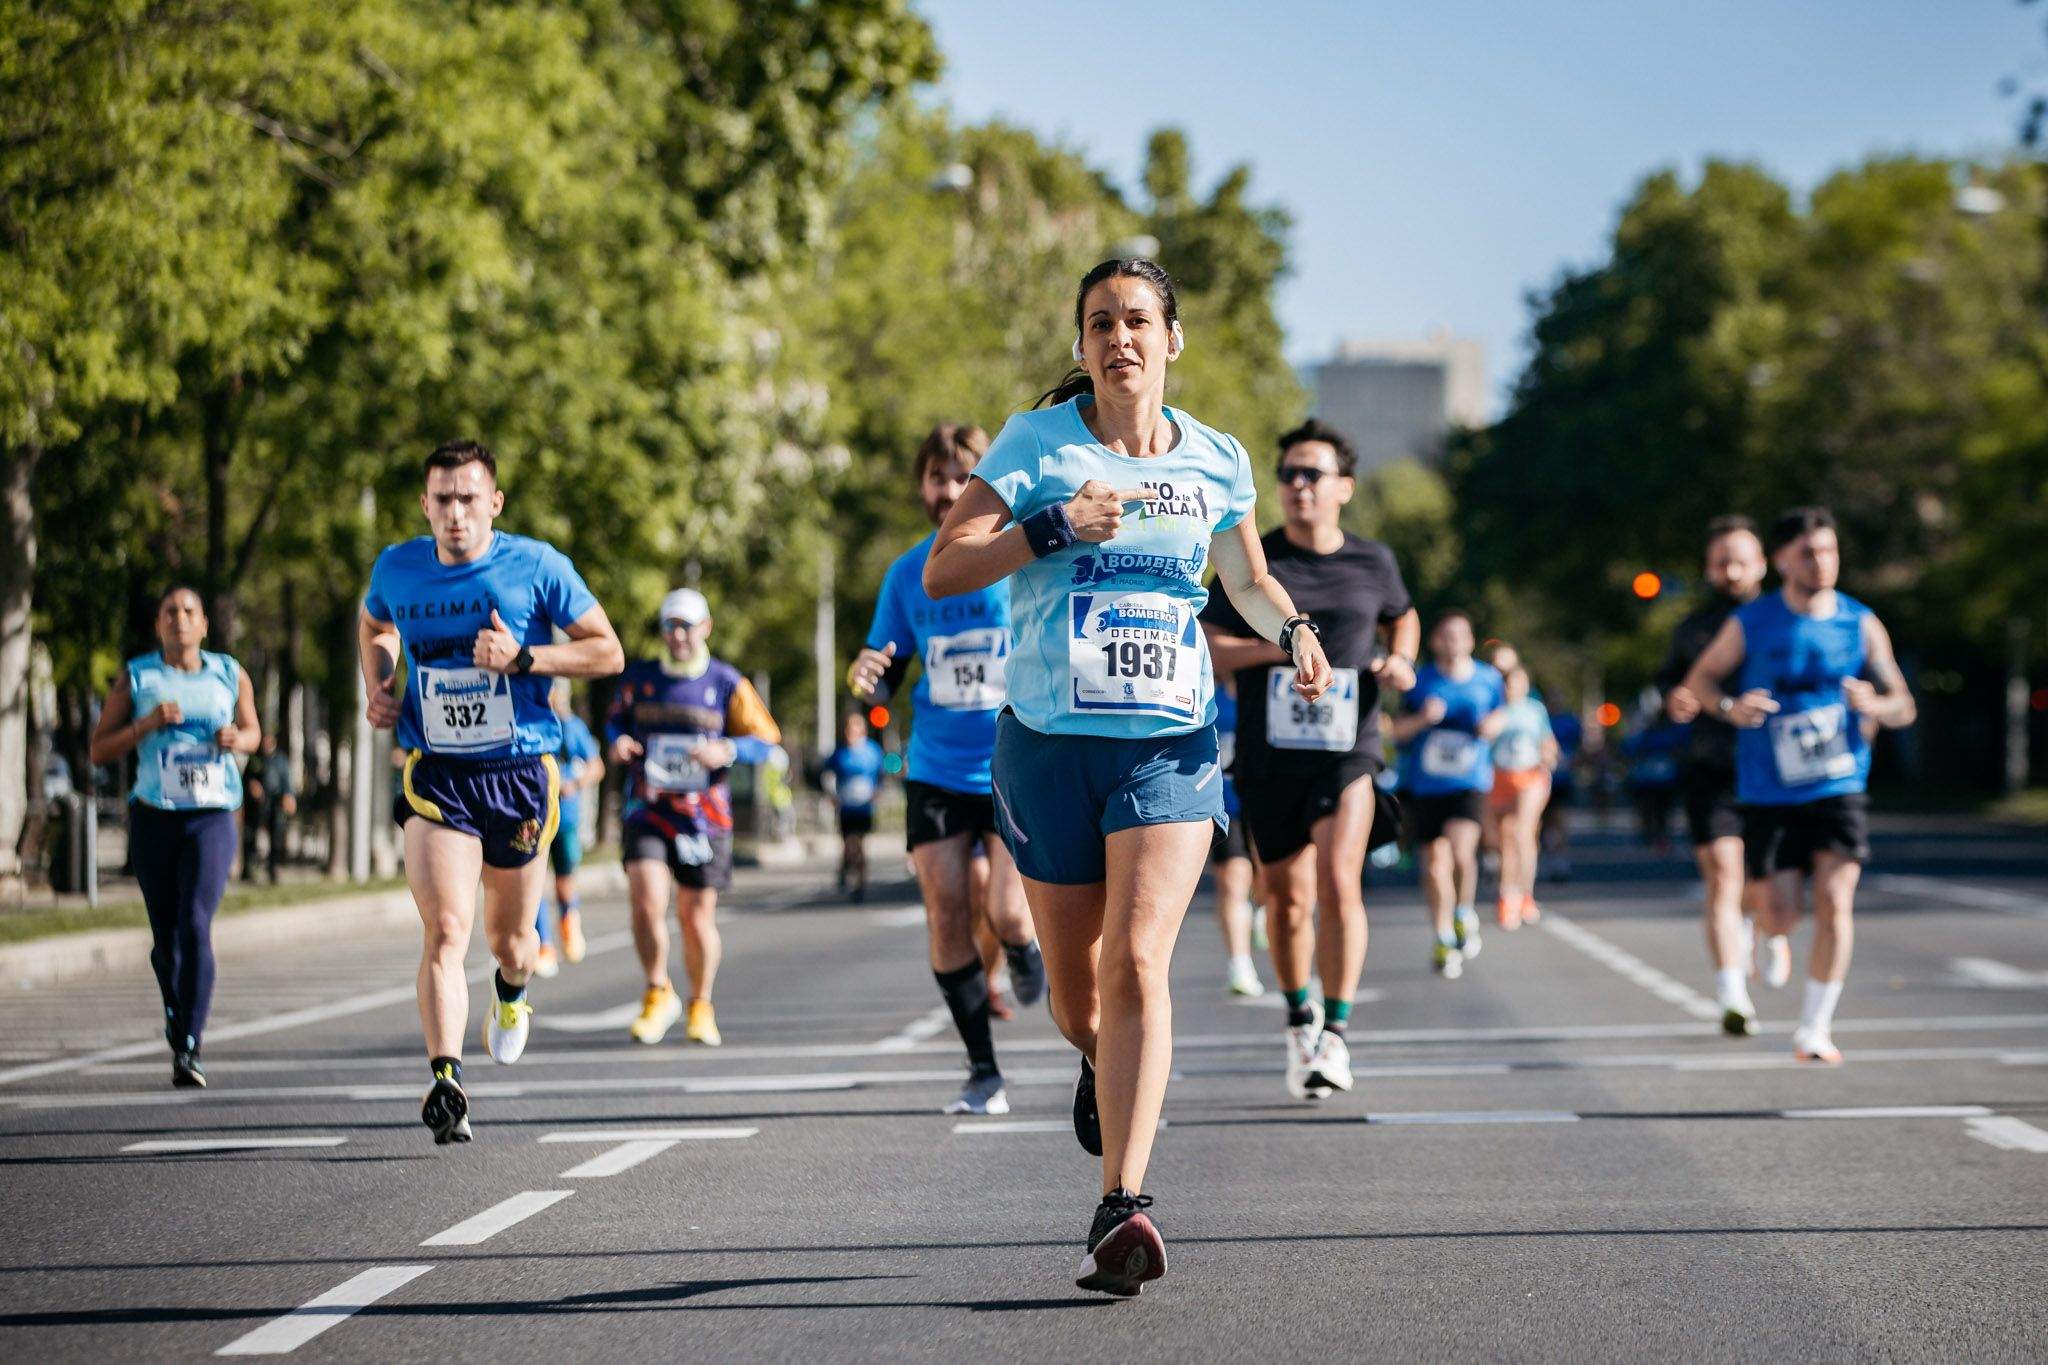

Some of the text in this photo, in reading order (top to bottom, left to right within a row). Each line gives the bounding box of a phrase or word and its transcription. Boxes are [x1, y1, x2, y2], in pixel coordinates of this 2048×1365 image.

[1182, 493, 1191, 502] la
[1145, 501, 1191, 516] TALA
[1108, 554, 1200, 574] BOMBEROS
[1118, 608, 1178, 625] BOMBEROS
[1111, 628, 1177, 645] DECIMAS
[1101, 641, 1177, 681] 1937
[954, 664, 985, 687] 154
[443, 701, 488, 728] 332
